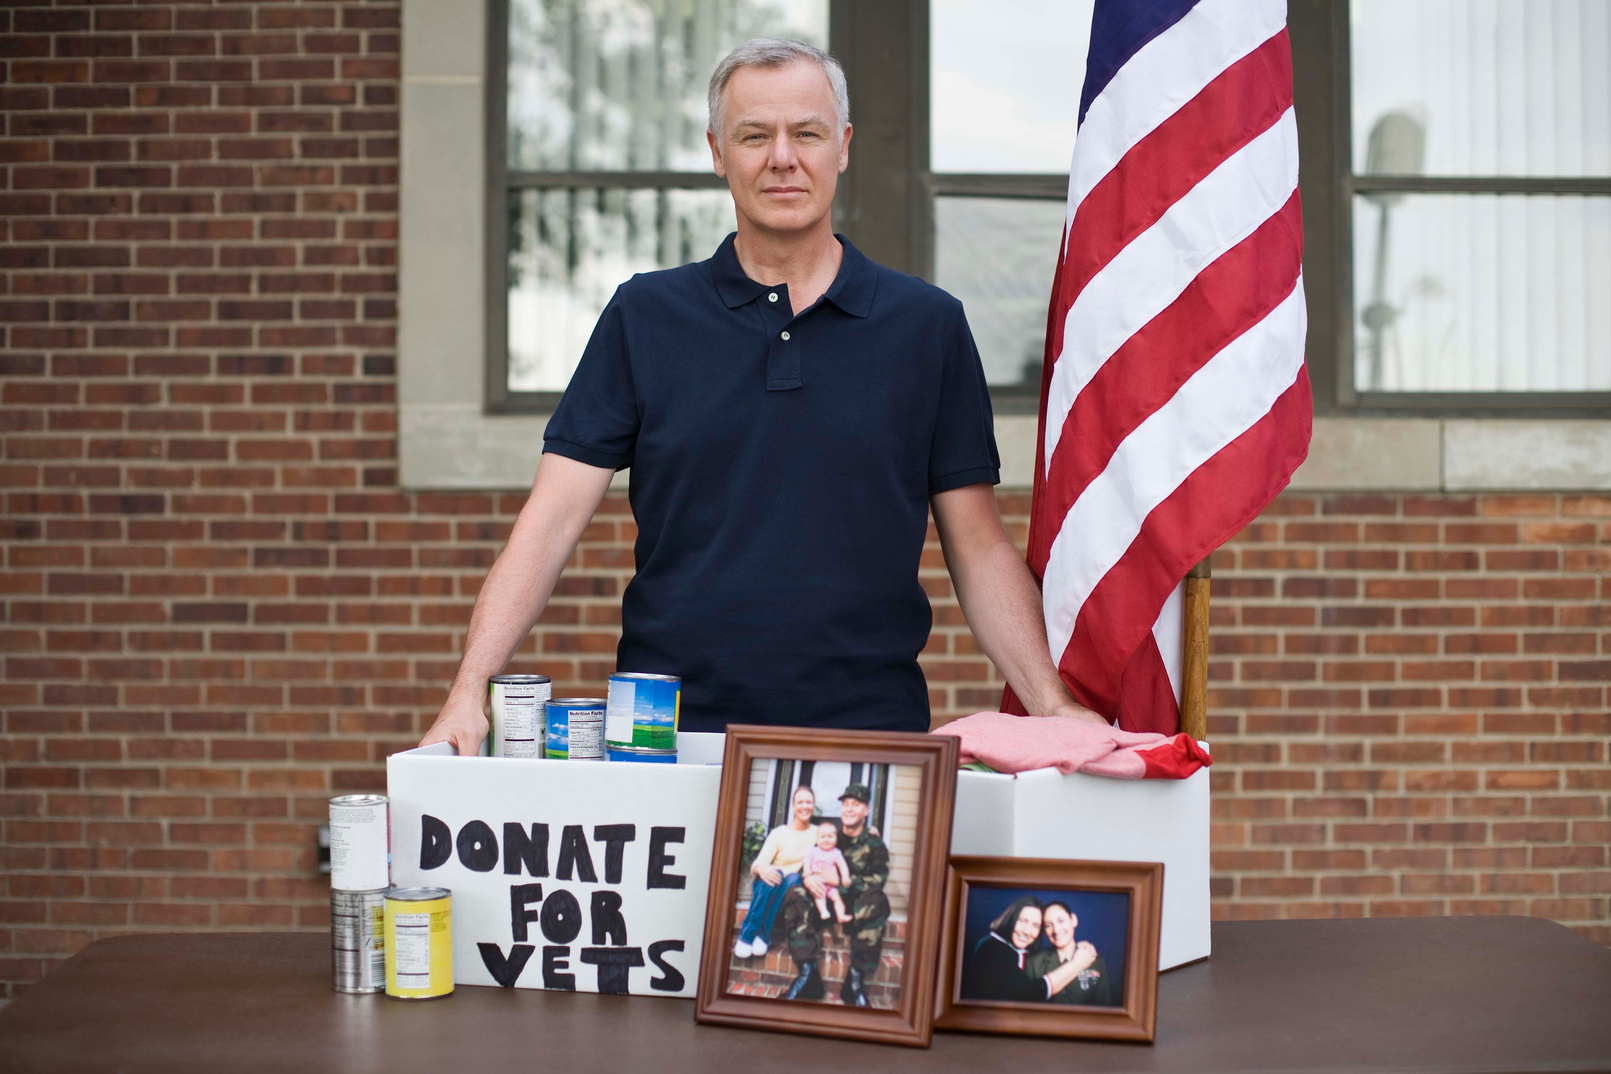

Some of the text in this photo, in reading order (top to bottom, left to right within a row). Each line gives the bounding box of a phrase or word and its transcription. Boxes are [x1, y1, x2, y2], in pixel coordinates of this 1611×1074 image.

[420, 814, 687, 890] DONATE
[510, 883, 628, 947] FOR
[478, 939, 685, 995] VETS
